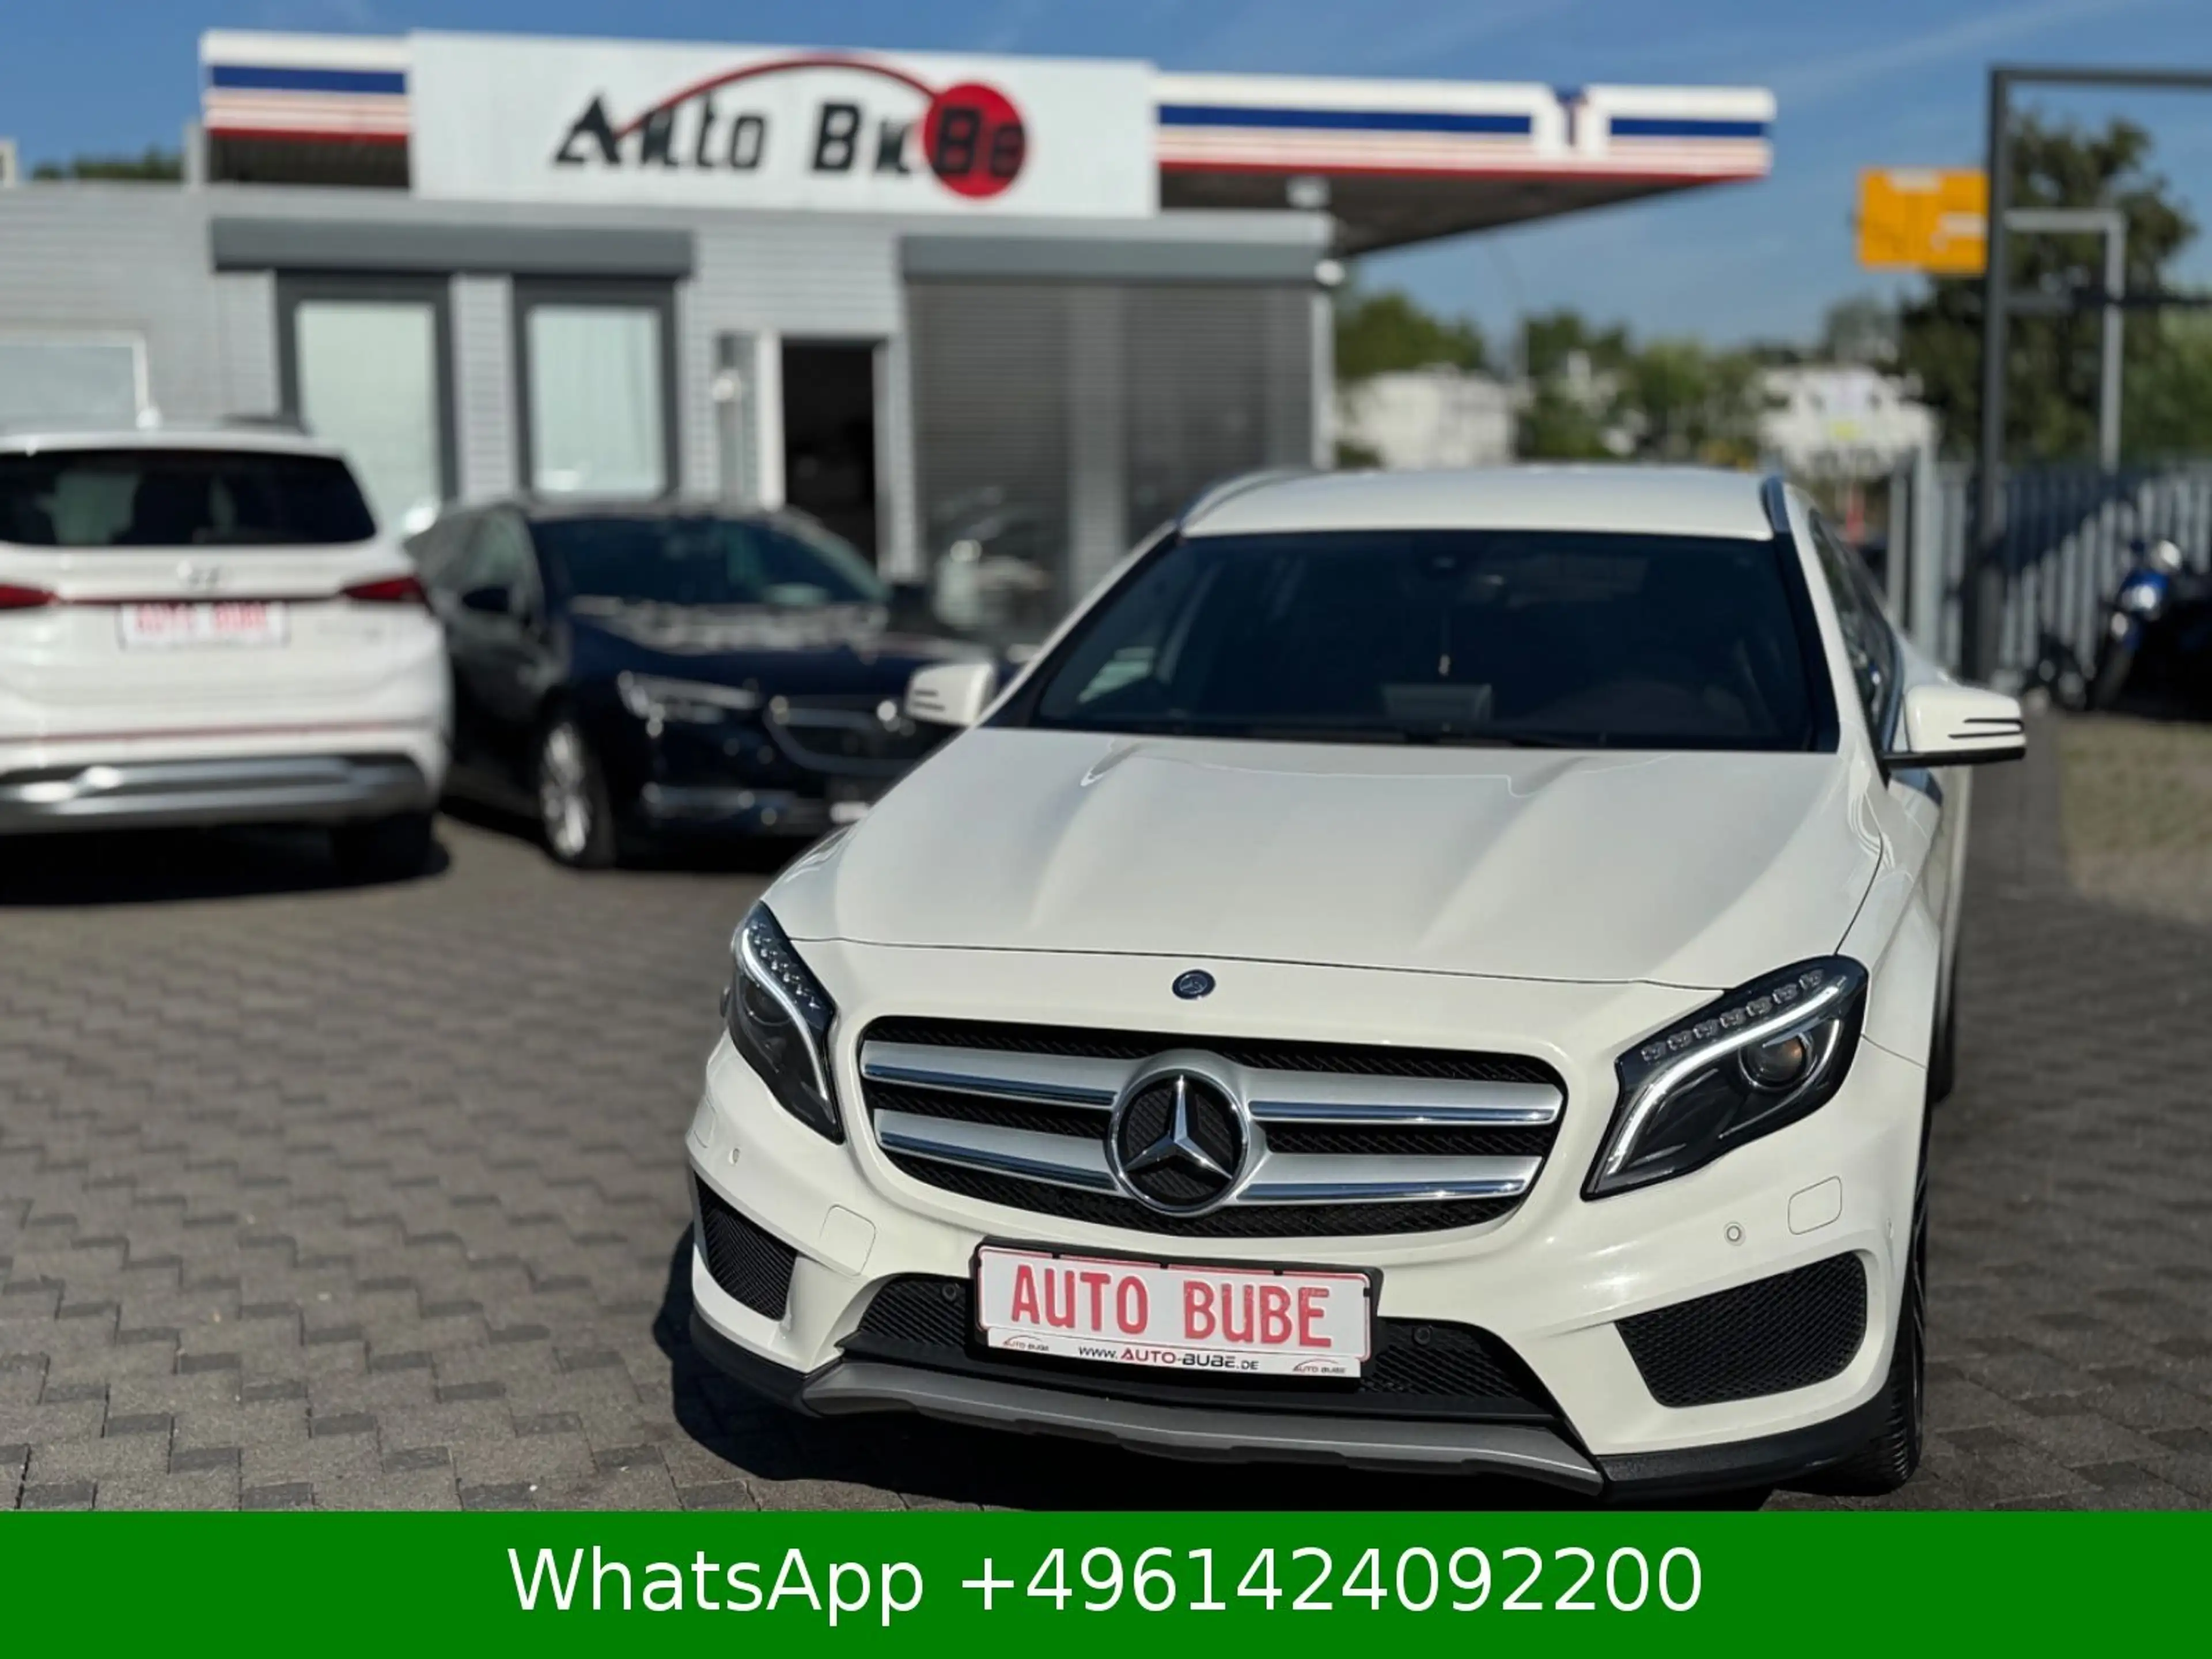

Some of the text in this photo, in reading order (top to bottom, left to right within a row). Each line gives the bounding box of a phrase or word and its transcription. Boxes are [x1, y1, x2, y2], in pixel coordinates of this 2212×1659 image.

[554, 90, 767, 169] Auto
[1012, 1264, 1332, 1348] AUTO BUBE
